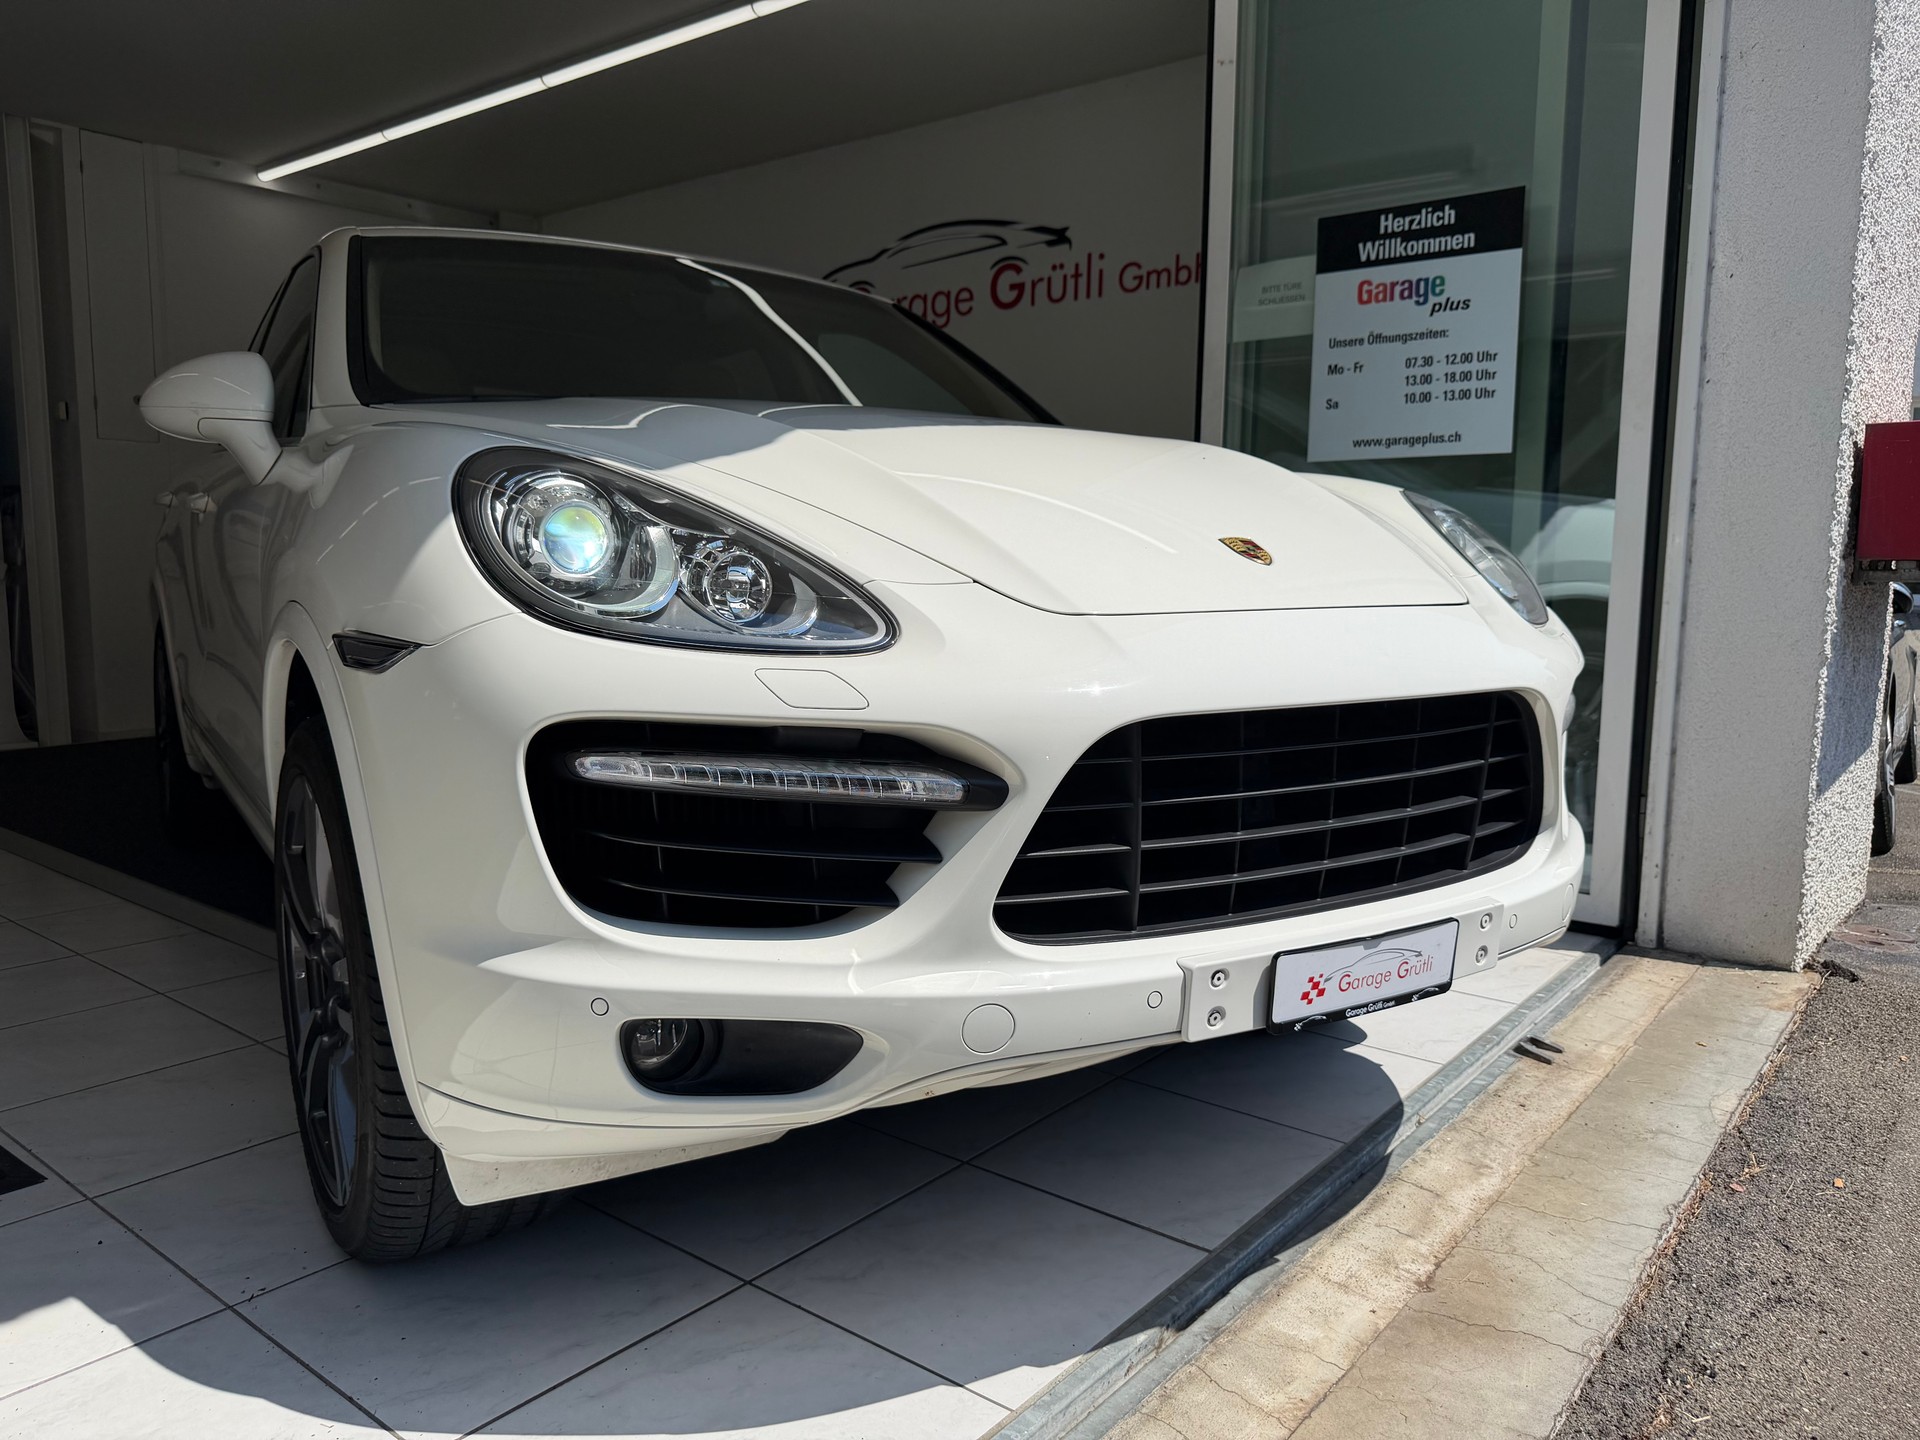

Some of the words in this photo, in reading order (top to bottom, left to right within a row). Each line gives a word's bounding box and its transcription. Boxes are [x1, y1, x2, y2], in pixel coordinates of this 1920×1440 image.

[1379, 204, 1456, 235] Herzlich
[1358, 232, 1475, 262] Willkommen
[990, 252, 1104, 310] Grütli
[1357, 275, 1446, 306] Garage
[1429, 297, 1471, 317] plus
[1329, 336, 1365, 349] Unsere
[1367, 329, 1449, 346] Öffnungszeiten:
[1327, 364, 1344, 376] Mo
[1353, 362, 1364, 374] Fr
[1405, 356, 1433, 369] 07.30
[1445, 352, 1473, 365] 12.00
[1477, 351, 1498, 363] Uhr
[1404, 374, 1432, 386] 13.00
[1444, 371, 1472, 384] 18.00
[1476, 369, 1497, 381] Uhr
[1325, 399, 1339, 410] Sa
[1404, 392, 1431, 404] 10.00
[1443, 389, 1471, 401] 13.00
[1475, 387, 1496, 399] Uhr
[1352, 431, 1461, 449] www.garageplus.ch
[1338, 970, 1392, 993] Garage
[1397, 955, 1434, 979] Grütli
[1345, 1006, 1368, 1017] Garage
